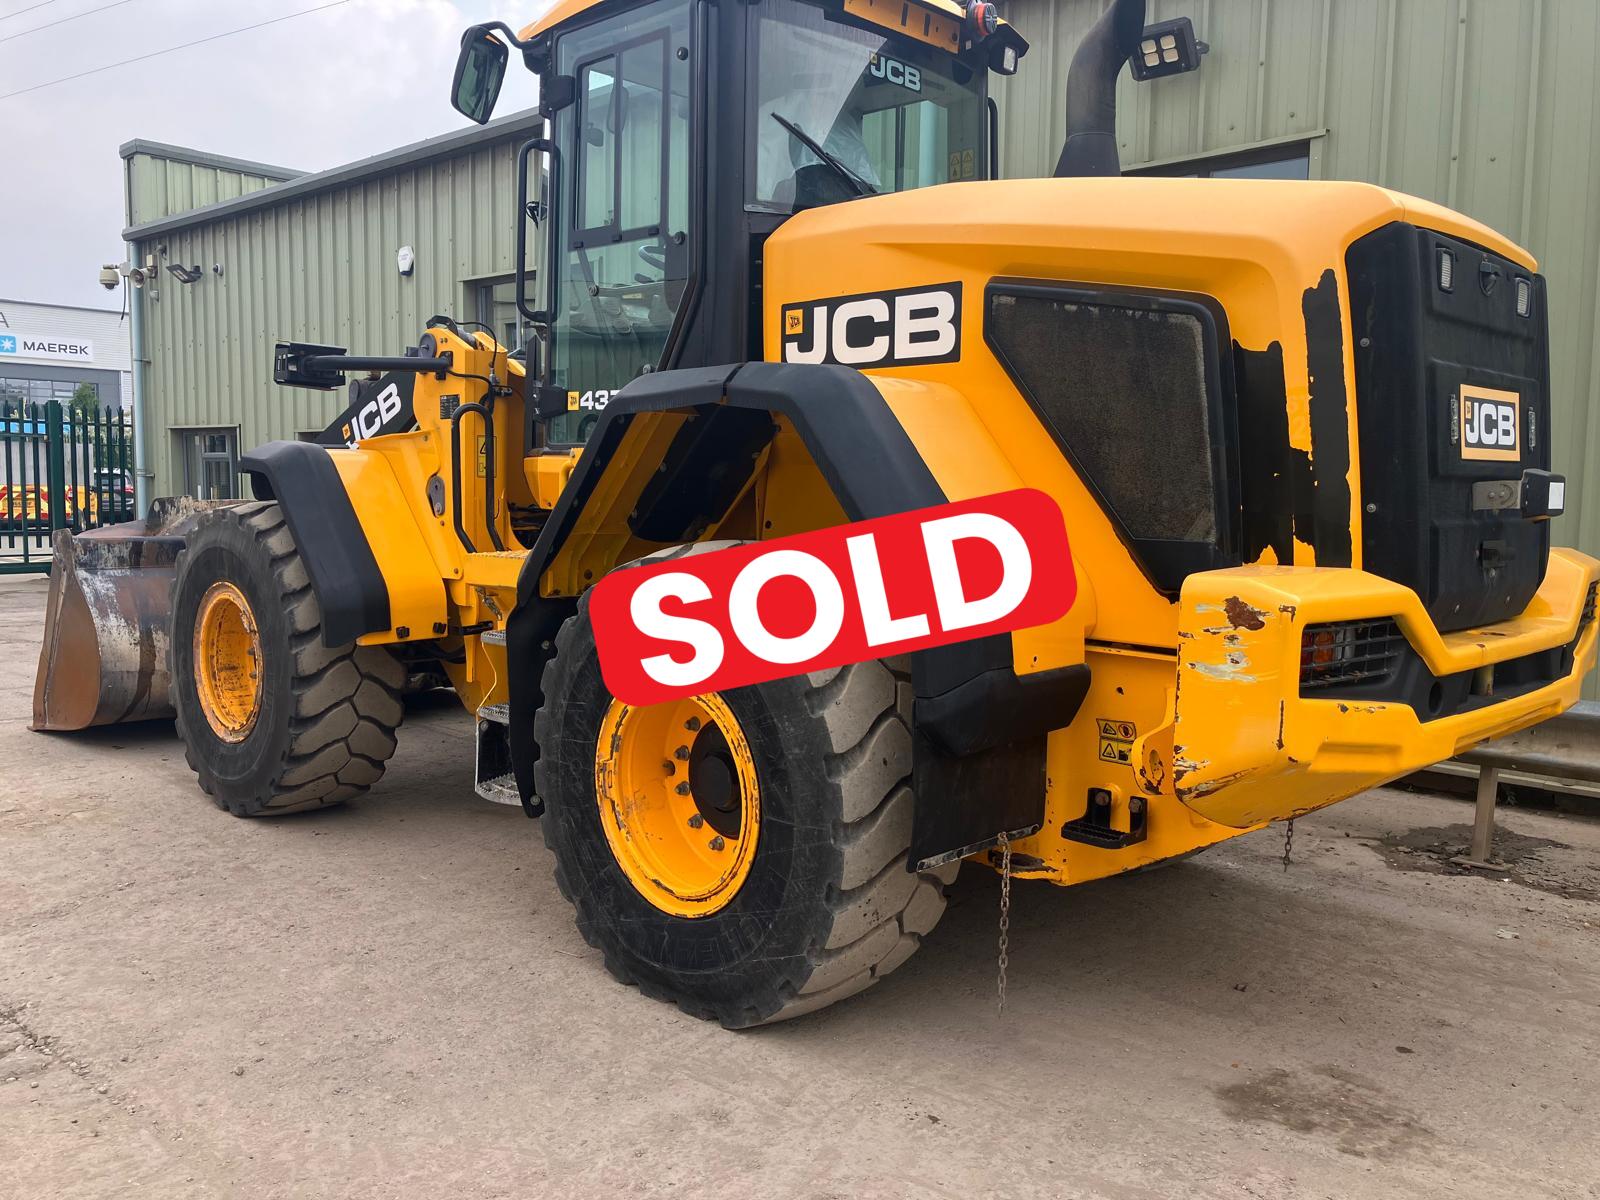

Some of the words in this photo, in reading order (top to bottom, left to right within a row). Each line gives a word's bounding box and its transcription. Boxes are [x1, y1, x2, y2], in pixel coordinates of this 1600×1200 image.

[870, 56, 921, 91] JCB
[23, 341, 89, 355] MAERSK
[785, 290, 956, 365] JCB
[346, 382, 402, 450] JCB
[1465, 402, 1515, 446] JCB
